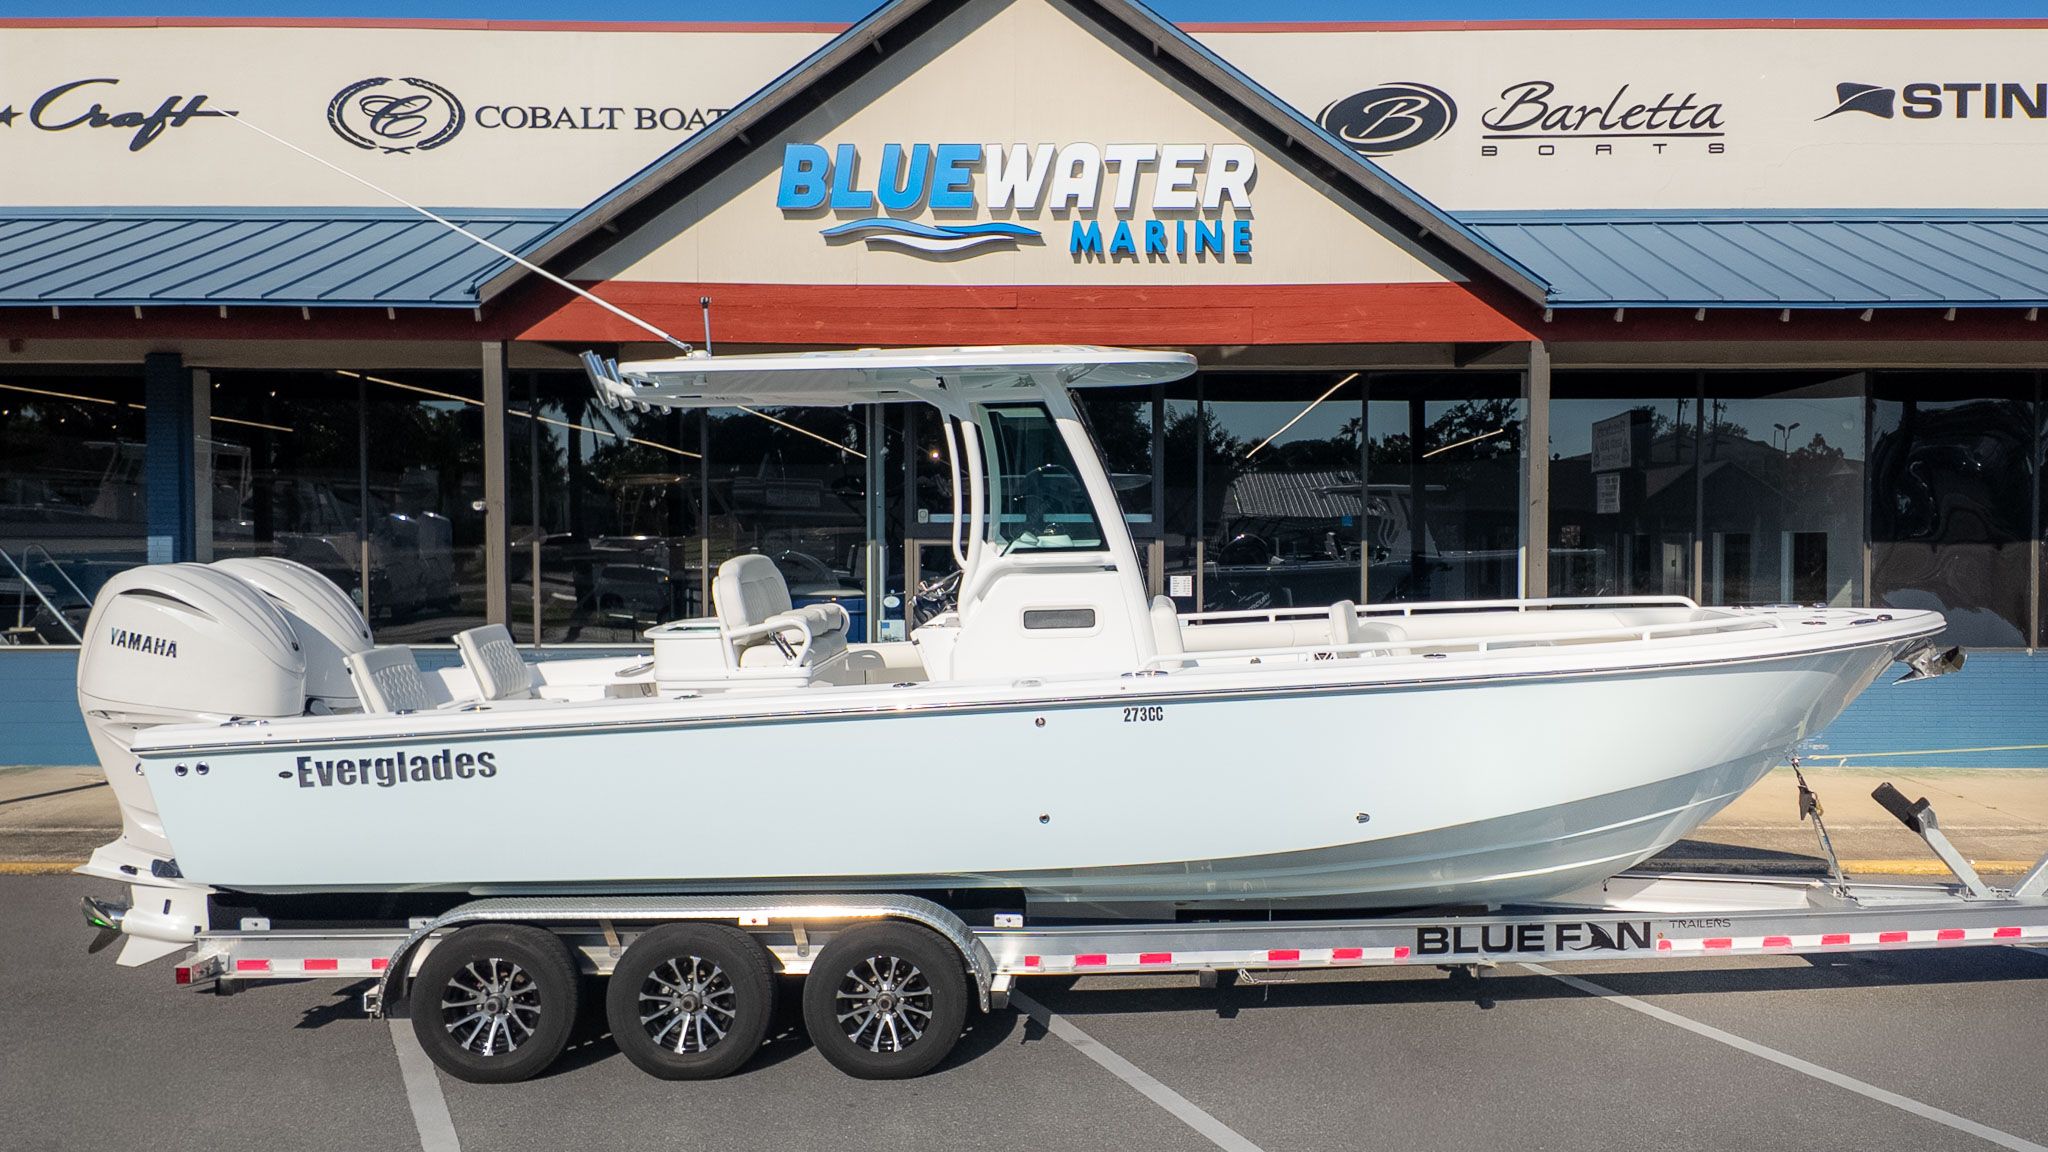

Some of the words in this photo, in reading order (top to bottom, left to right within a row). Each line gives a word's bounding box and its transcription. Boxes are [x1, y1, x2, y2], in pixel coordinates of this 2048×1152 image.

[30, 78, 240, 152] Craft
[475, 105, 625, 130] COBALT
[1481, 80, 1726, 132] Barletta
[1902, 82, 2047, 119] STIN
[1481, 143, 1725, 156] BOATS
[776, 142, 1257, 214] BLUEWATER
[1069, 219, 1254, 256] MARINE
[110, 627, 177, 658] YAMAHA
[1123, 706, 1164, 722] 273CC
[296, 749, 498, 788] Everglades
[1669, 918, 1731, 928] TRAILERS
